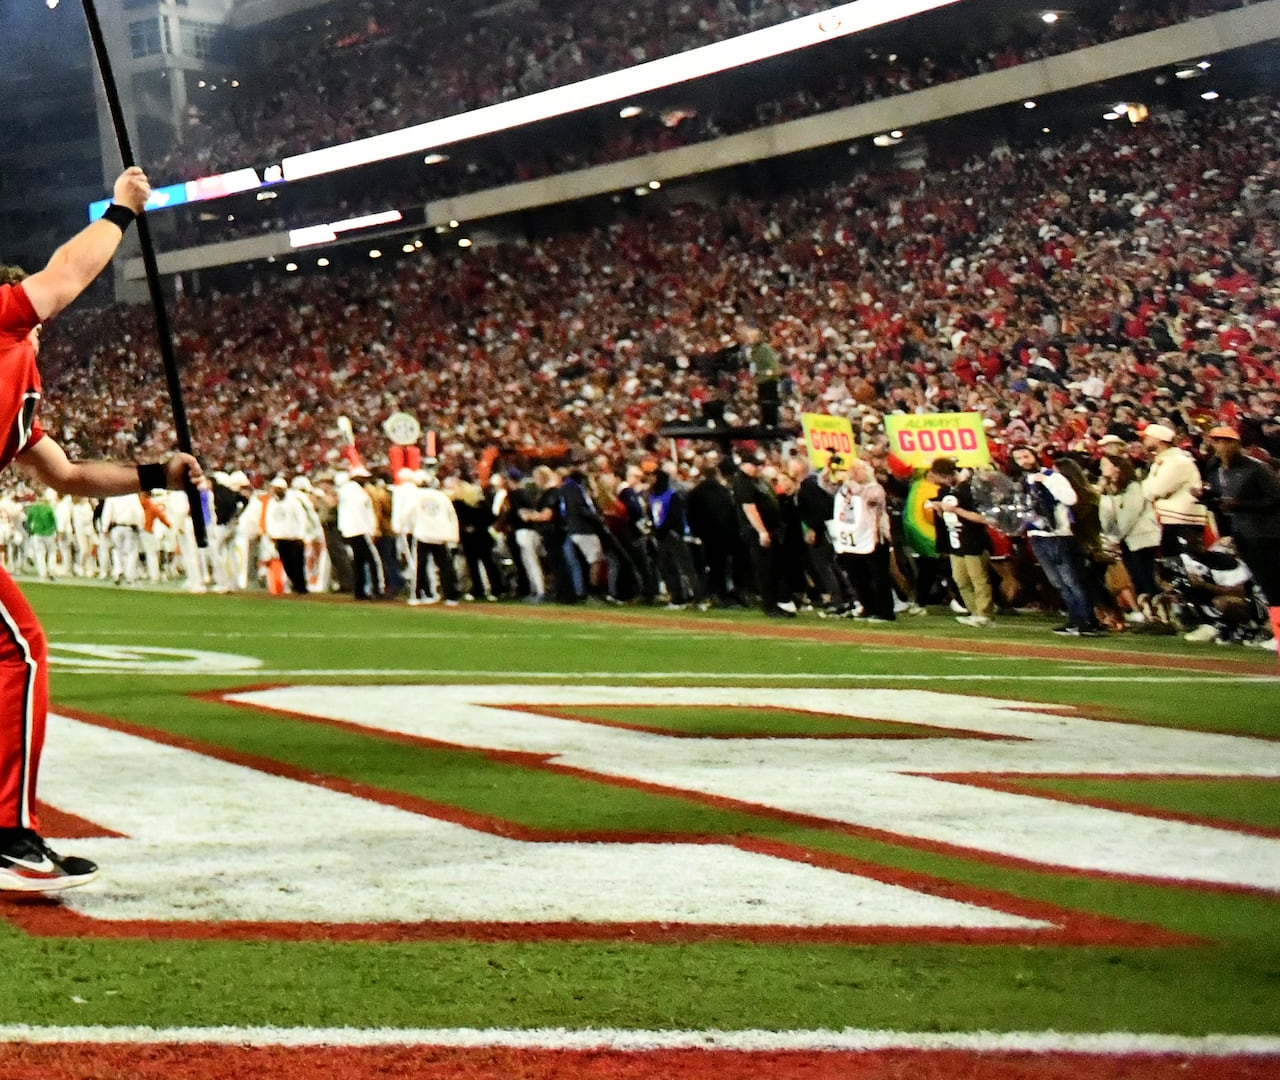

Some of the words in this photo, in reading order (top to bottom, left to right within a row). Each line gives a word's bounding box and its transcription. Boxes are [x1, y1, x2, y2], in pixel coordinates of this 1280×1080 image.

[907, 417, 961, 428] ALWAYS
[810, 428, 851, 453] GOOD
[898, 429, 978, 452] GOOD
